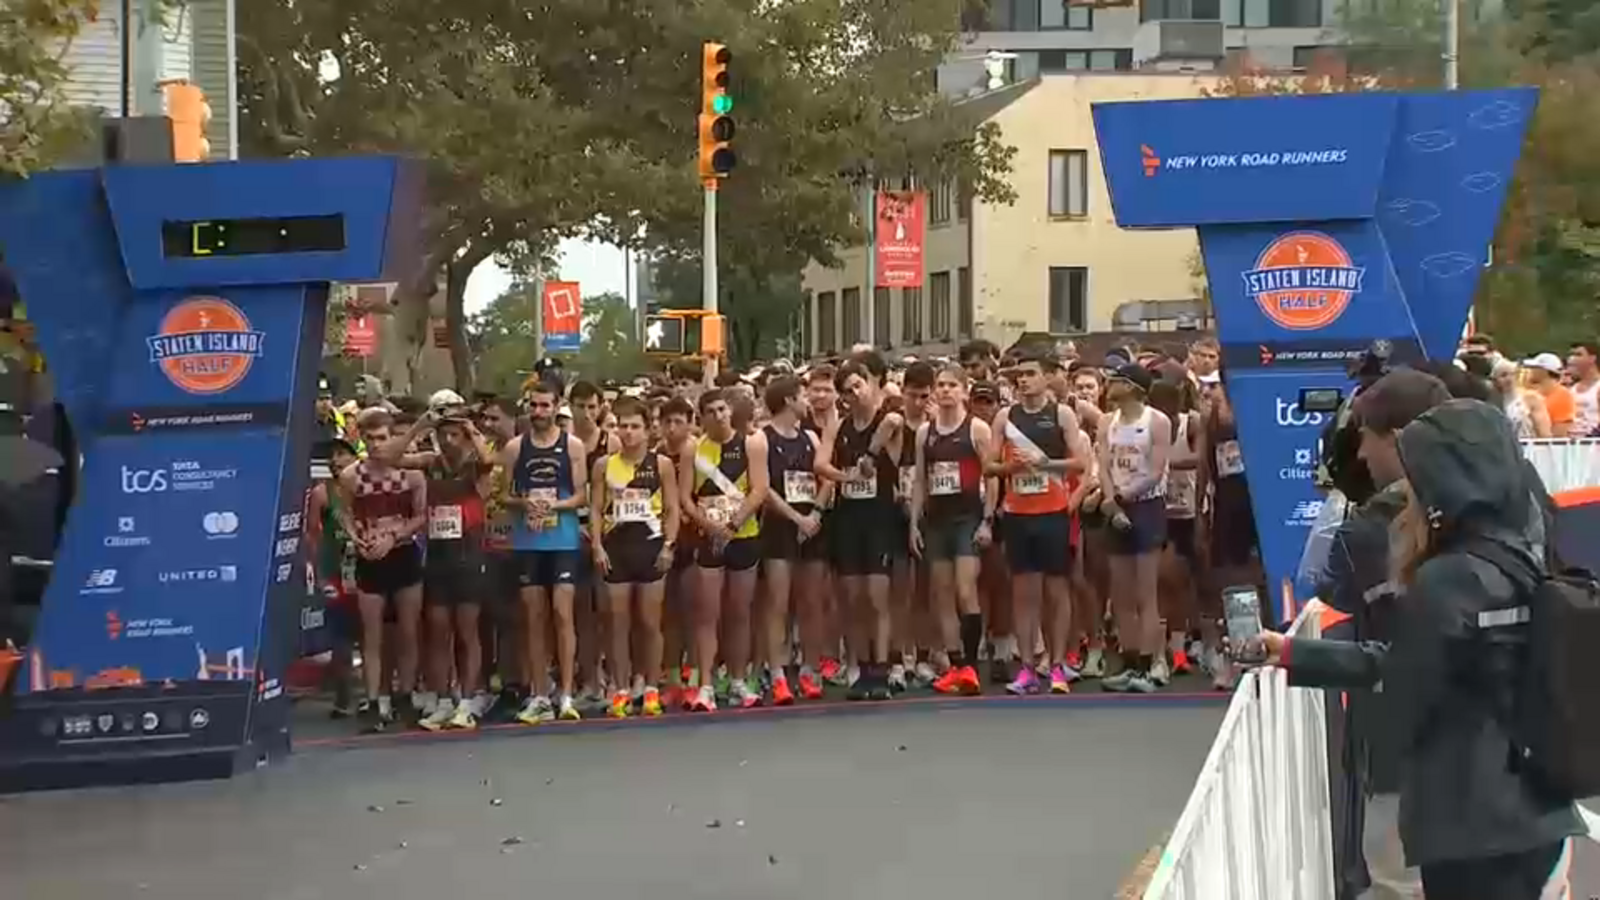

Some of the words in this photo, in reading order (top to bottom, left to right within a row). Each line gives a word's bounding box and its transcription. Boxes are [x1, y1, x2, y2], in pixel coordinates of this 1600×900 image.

[1165, 157, 1198, 169] NEW
[1201, 155, 1237, 168] YORK
[1240, 152, 1280, 166] ROAD
[1281, 149, 1348, 164] RUNNERS
[1249, 269, 1300, 291] STATEN
[1306, 268, 1357, 288] ISLAND
[153, 334, 203, 357] STATEN
[208, 333, 257, 352] ISLAND
[1321, 351, 1345, 359] ROAD
[181, 358, 232, 374] HALF
[121, 465, 167, 493] tcs
[158, 570, 218, 582] UNITED
